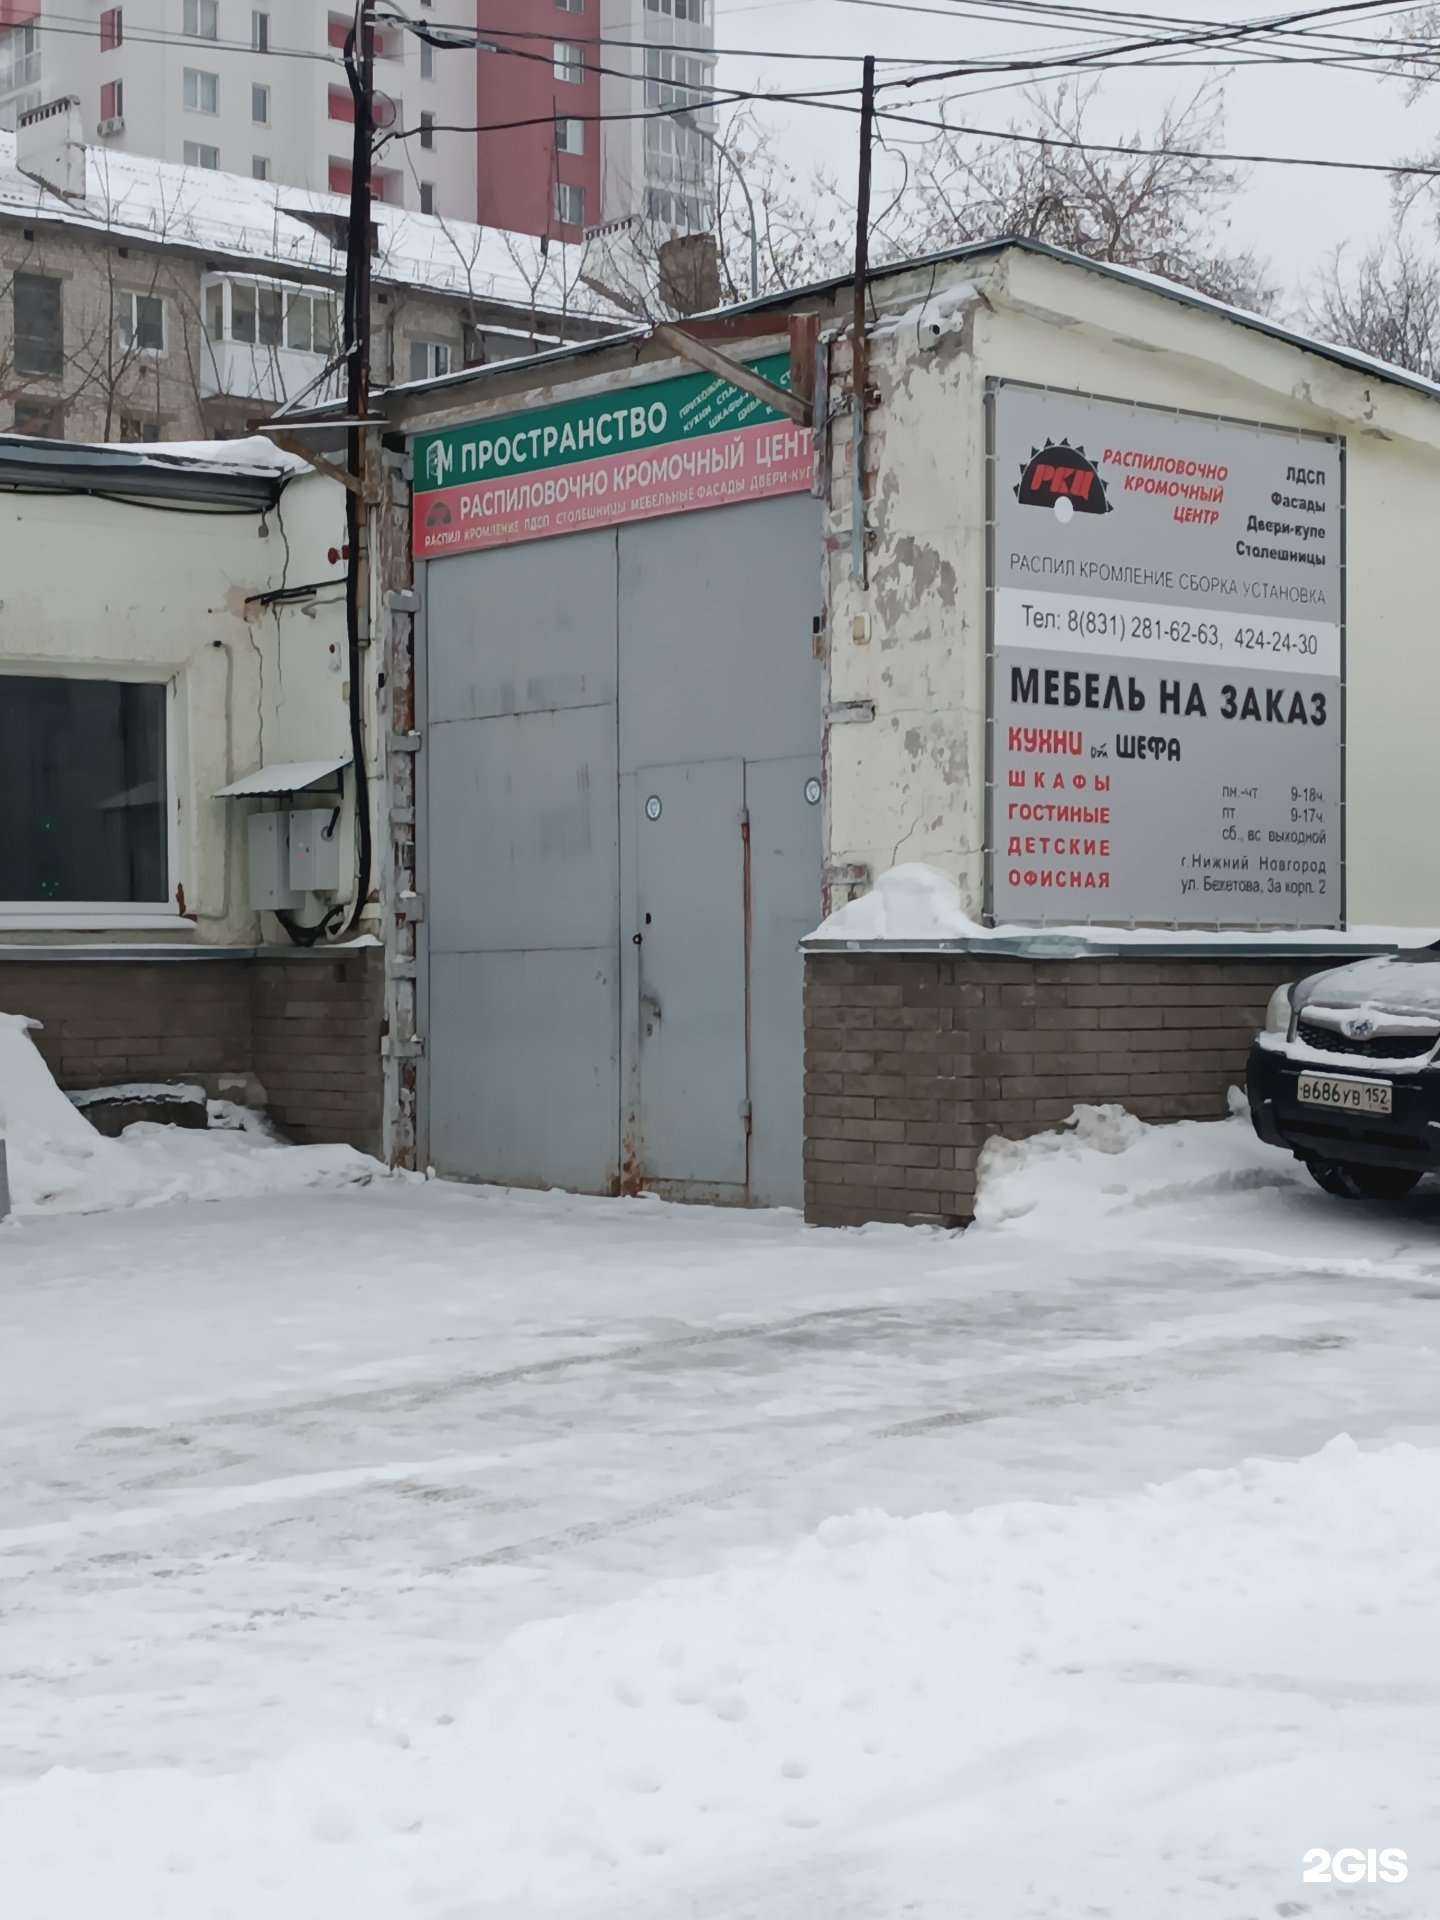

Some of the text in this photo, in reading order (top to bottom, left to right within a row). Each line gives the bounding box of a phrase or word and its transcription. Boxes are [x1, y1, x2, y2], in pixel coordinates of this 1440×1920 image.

[461, 401, 668, 473] ПРОСТРАНСТВО
[460, 427, 816, 520] РАСПИЛОВОЧНО КРОМОЧНЫЙ ЦЕНТ
[1102, 449, 1228, 481] РАСПИЛОВОЧНО
[1286, 466, 1326, 486] ЛДСП
[1030, 463, 1094, 501] РКЦ
[1124, 475, 1225, 503] КРОМОЧНЫЙ
[425, 531, 461, 547] РАСПИЛ
[464, 520, 519, 541] КРОМЛЕНИЕ
[556, 501, 627, 525] СТОЛЕШНИЦЫ
[631, 488, 695, 511] МЕБЕЛЬНЫЕ
[697, 478, 745, 499] ФАСАДЫ
[1173, 506, 1220, 525] ЦЕНТР
[1271, 492, 1326, 514] Фасады
[1246, 515, 1326, 541] Двери-купе
[1236, 540, 1326, 567] Столешницы
[1010, 553, 1327, 605] РАСПИЛ КРОМЛЕНИЕ СБОРКА УСТАНОВКА
[1021, 604, 1319, 656] Тел: 8(831) 281-62-63, 424-24-30
[1010, 667, 1328, 727] МЕБЕЛЬ НА ЗАКАЗ
[1008, 726, 1083, 756] КУХНИ
[1116, 733, 1182, 763] ШЕФА
[1008, 769, 1111, 792] ШКАФЫ
[1008, 803, 1111, 824] ГОСТИНЫЕ
[1008, 836, 1111, 857] ДЕТСКИЕ
[1247, 829, 1261, 842] вс
[1268, 829, 1327, 845] выходной
[1008, 868, 1111, 889] ОФИСНАЯ
[1259, 856, 1327, 875] Новгород
[1181, 878, 1199, 895] ул.
[1319, 879, 1327, 895] 2
[1365, 1088, 1388, 1105] 152
